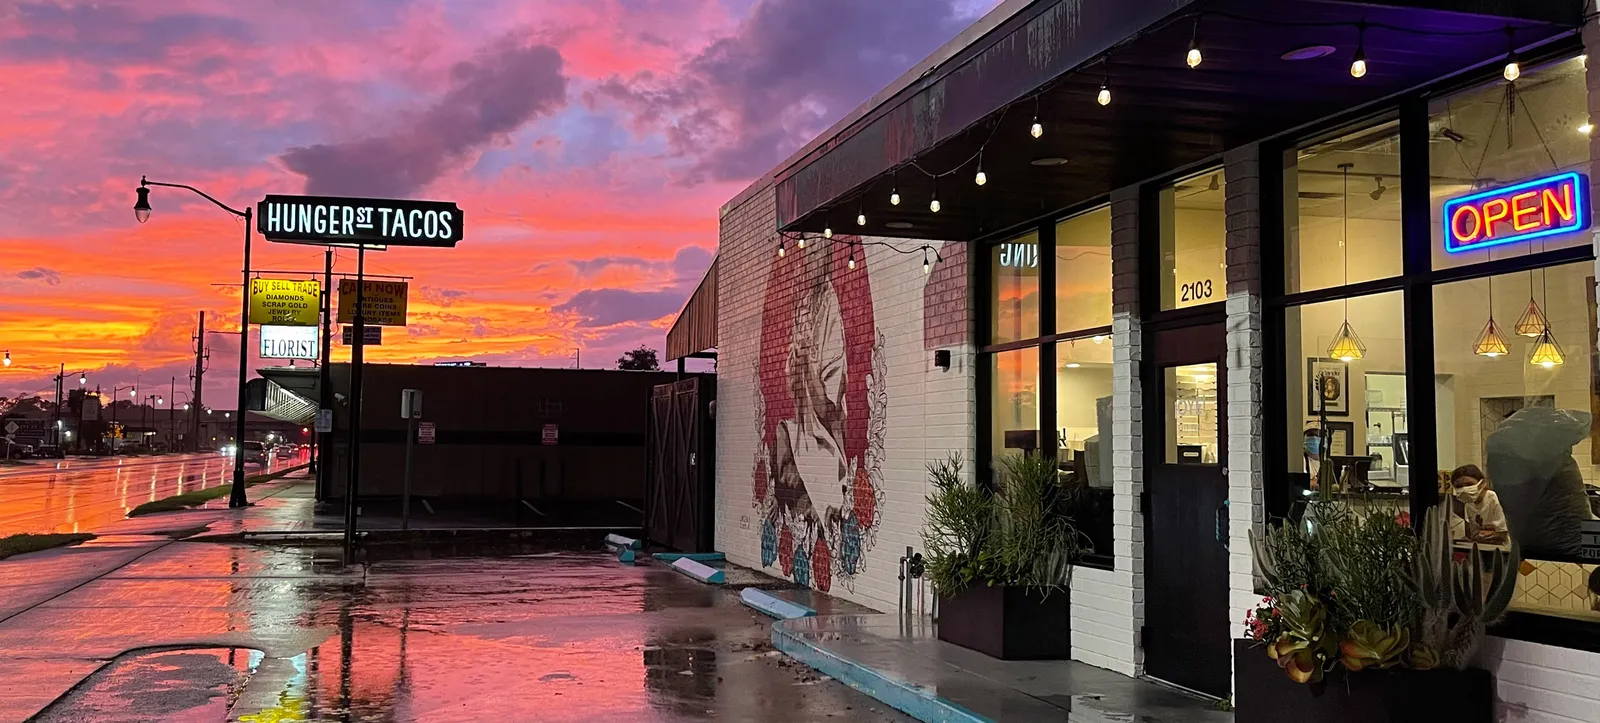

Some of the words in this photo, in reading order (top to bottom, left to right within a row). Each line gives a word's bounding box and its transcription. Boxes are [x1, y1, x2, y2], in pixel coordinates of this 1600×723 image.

[268, 203, 354, 235] HUNGER
[356, 206, 374, 225] ST
[378, 208, 453, 239] TACOS
[1452, 184, 1573, 242] OPEN
[253, 281, 269, 295] BUY
[272, 282, 290, 291] SELL
[293, 283, 318, 297] TRADE
[342, 282, 372, 295] CAH
[376, 283, 404, 298] NOW
[1181, 280, 1212, 302] 2103
[262, 339, 315, 357] FLORIST
